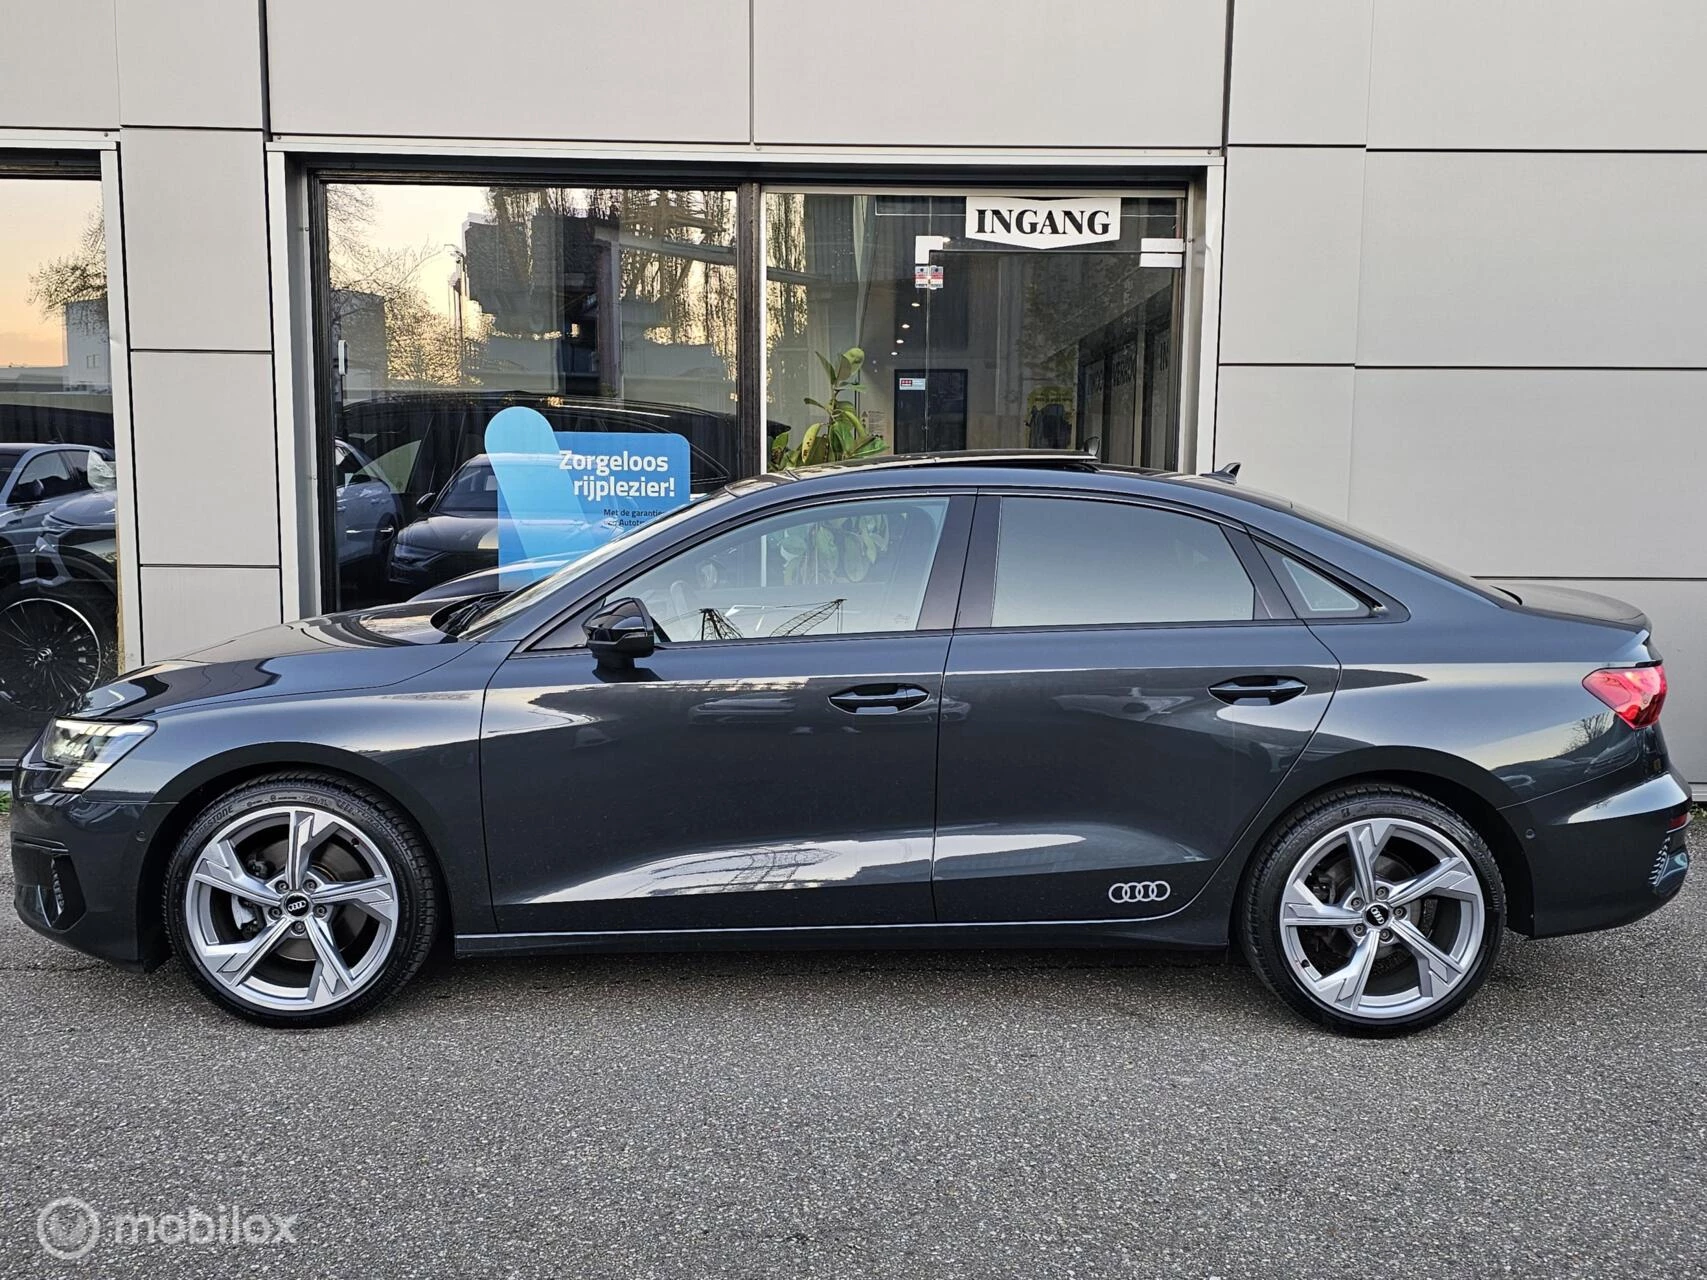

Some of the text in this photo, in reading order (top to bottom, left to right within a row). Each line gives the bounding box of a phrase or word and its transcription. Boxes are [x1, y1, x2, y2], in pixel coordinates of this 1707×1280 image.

[975, 209, 1111, 235] INGANG
[559, 450, 668, 476] Zorgeloos
[574, 476, 675, 501] rijplezier!
[603, 509, 618, 517] Met
[620, 508, 630, 517] de
